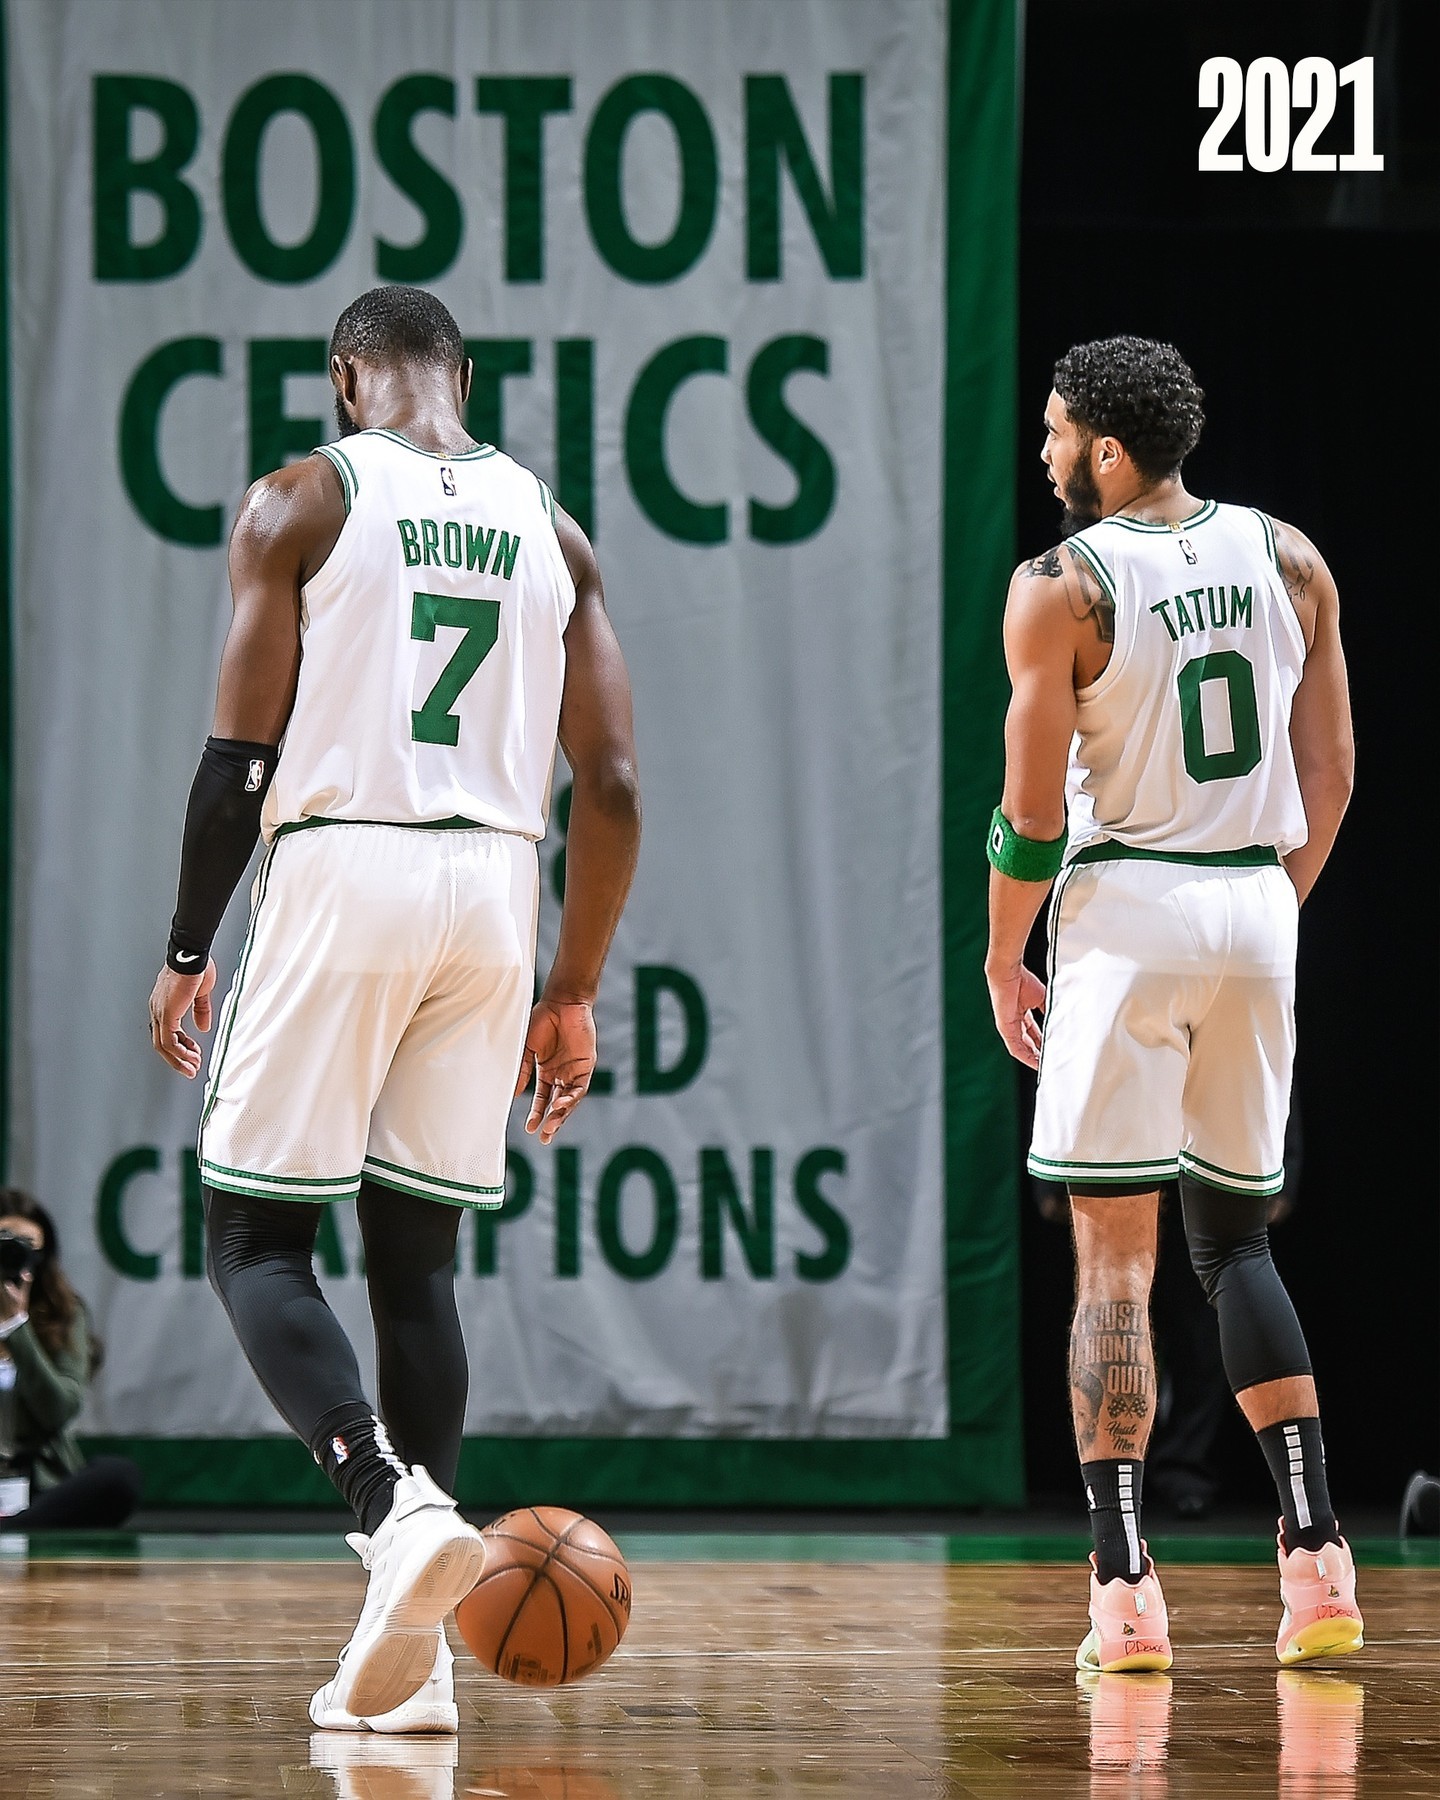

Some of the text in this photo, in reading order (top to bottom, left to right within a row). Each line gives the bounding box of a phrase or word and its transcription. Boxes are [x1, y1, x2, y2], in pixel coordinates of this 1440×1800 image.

[91, 71, 865, 286] BOSTON
[117, 334, 838, 550] CETICS
[398, 518, 521, 580] BROWN
[1150, 585, 1253, 641] TATUM
[410, 592, 501, 747] 7
[1177, 650, 1262, 784] 0
[95, 1144, 853, 1283] CPIONS
[1106, 1364, 1147, 1396] QUIT
